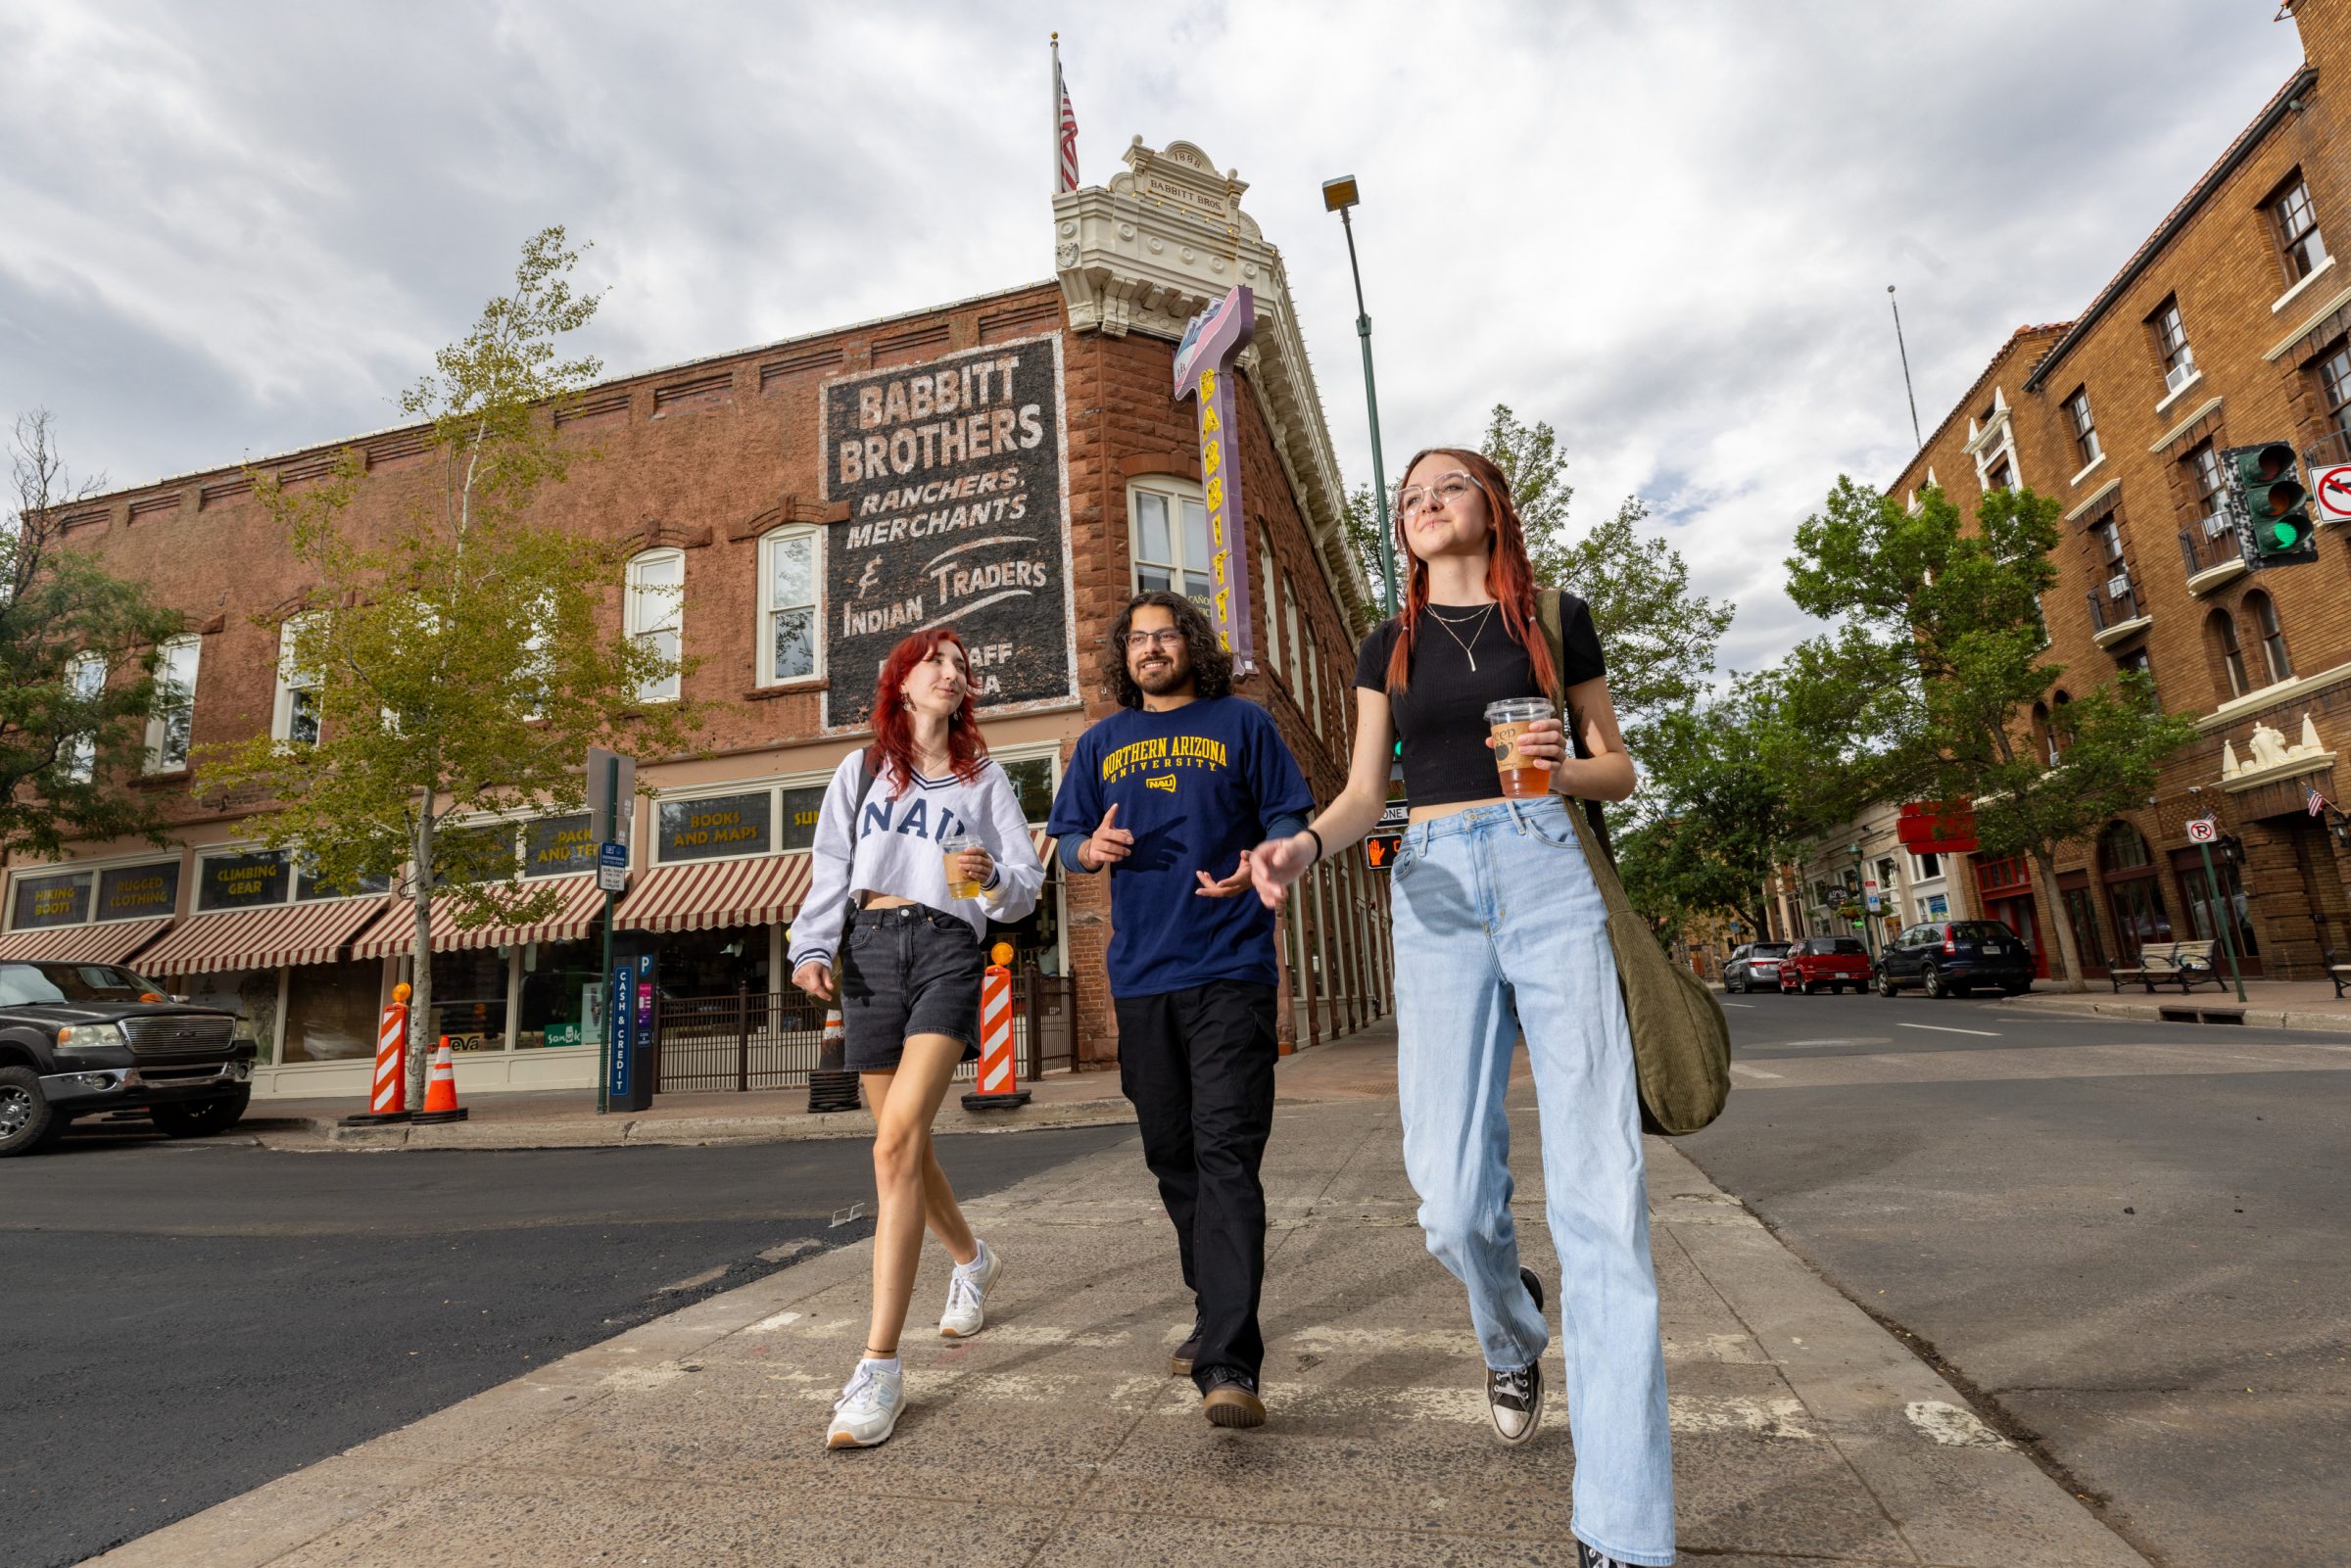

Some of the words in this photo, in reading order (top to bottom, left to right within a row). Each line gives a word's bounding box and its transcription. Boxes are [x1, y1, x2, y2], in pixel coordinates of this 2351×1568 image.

[1175, 152, 1201, 168] 1888
[1150, 179, 1194, 201] BABBITT
[1197, 195, 1223, 211] BROS.
[859, 356, 1020, 430] BABBITT
[840, 404, 1043, 485] BROTHERS
[859, 467, 1026, 517] RANCHERS,
[845, 494, 1028, 550] MERCHANTS
[857, 554, 883, 599] &
[843, 594, 923, 638] INDIAN
[931, 560, 1047, 606] TRADERS
[1102, 736, 1168, 782] NORTHERN
[1171, 736, 1227, 767] ARIZONA
[1111, 757, 1217, 784] UNIVERSITY
[1149, 778, 1173, 789] NAU
[690, 810, 742, 829] BOOKS
[673, 832, 709, 847] AND
[713, 825, 758, 844] MAPS
[537, 847, 571, 863] AND
[217, 864, 277, 882] CLIMBING
[34, 886, 75, 902] HIKING
[117, 877, 164, 892] RUGGED
[227, 880, 263, 896] GEAR
[33, 901, 71, 917] BOOTS
[110, 891, 168, 908] CLOTHING
[641, 956, 649, 973] P
[618, 972, 627, 1011] CASH
[618, 1016, 625, 1025] &
[616, 1029, 625, 1090] CREDIT
